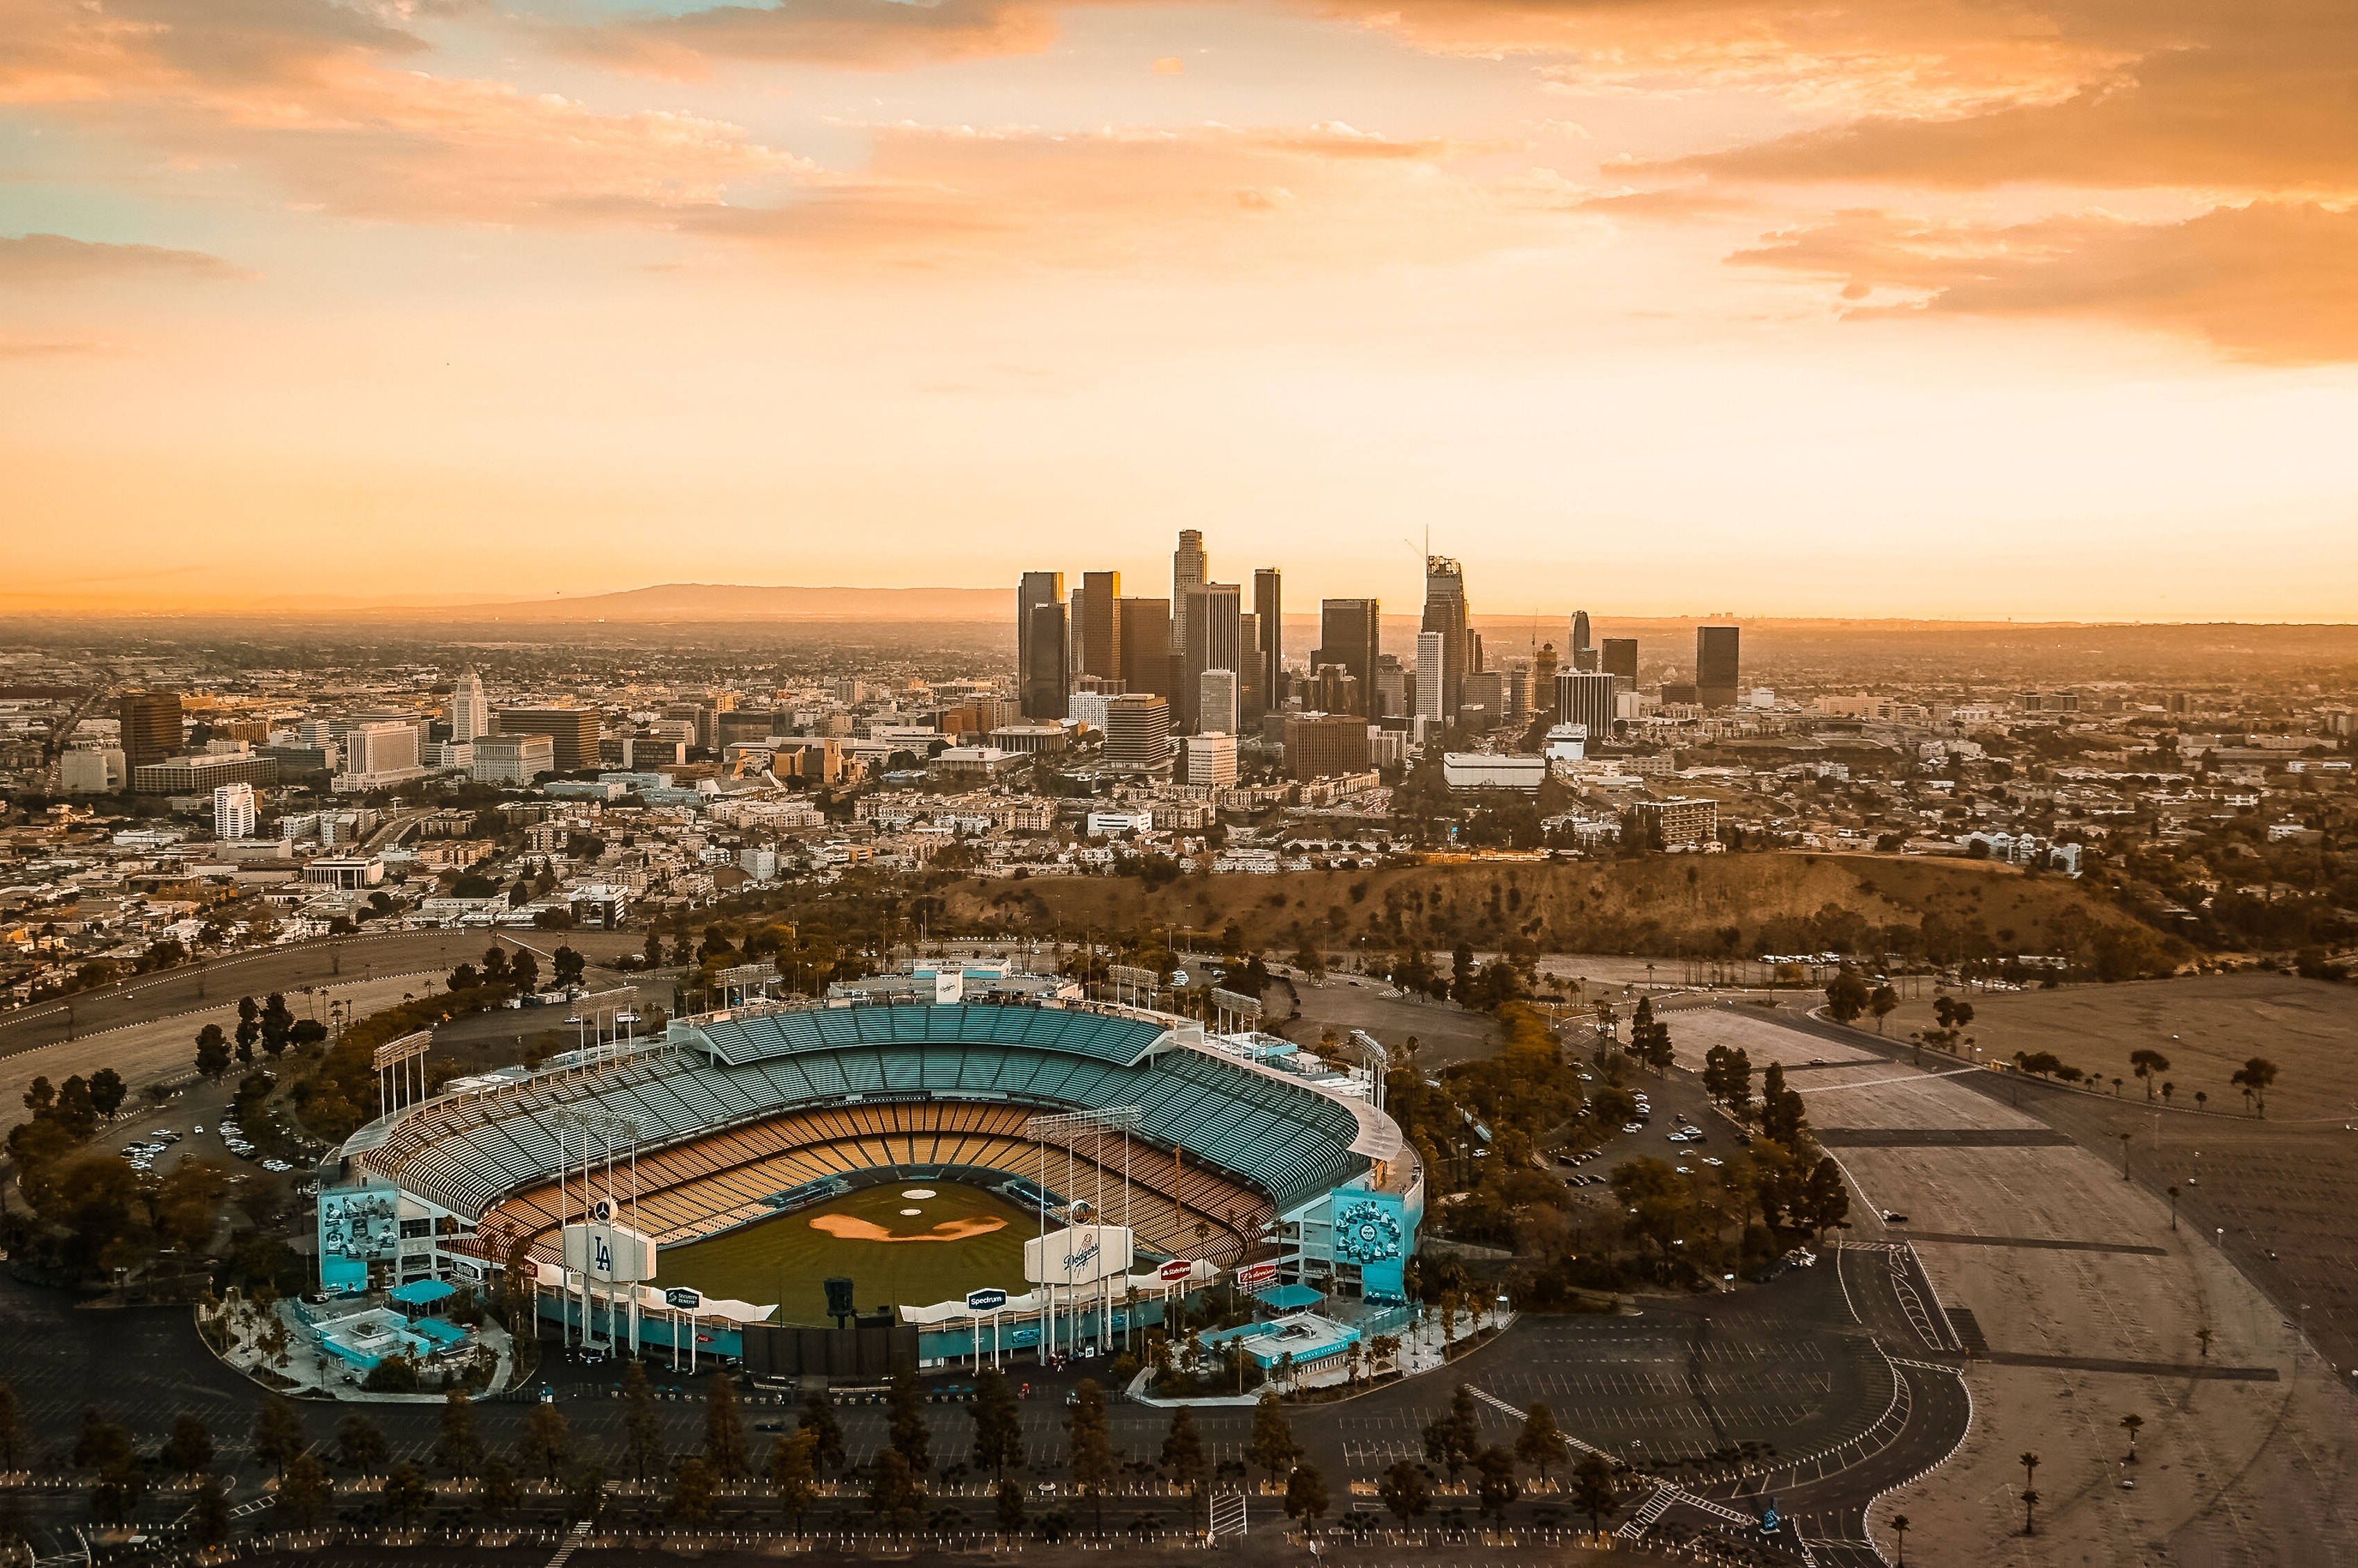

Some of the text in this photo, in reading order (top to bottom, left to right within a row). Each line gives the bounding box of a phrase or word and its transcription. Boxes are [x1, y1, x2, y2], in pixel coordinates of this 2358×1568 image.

[594, 1235, 611, 1272] LA
[1063, 1243, 1099, 1270] Dodgers
[971, 1296, 1001, 1306] Spectrum
